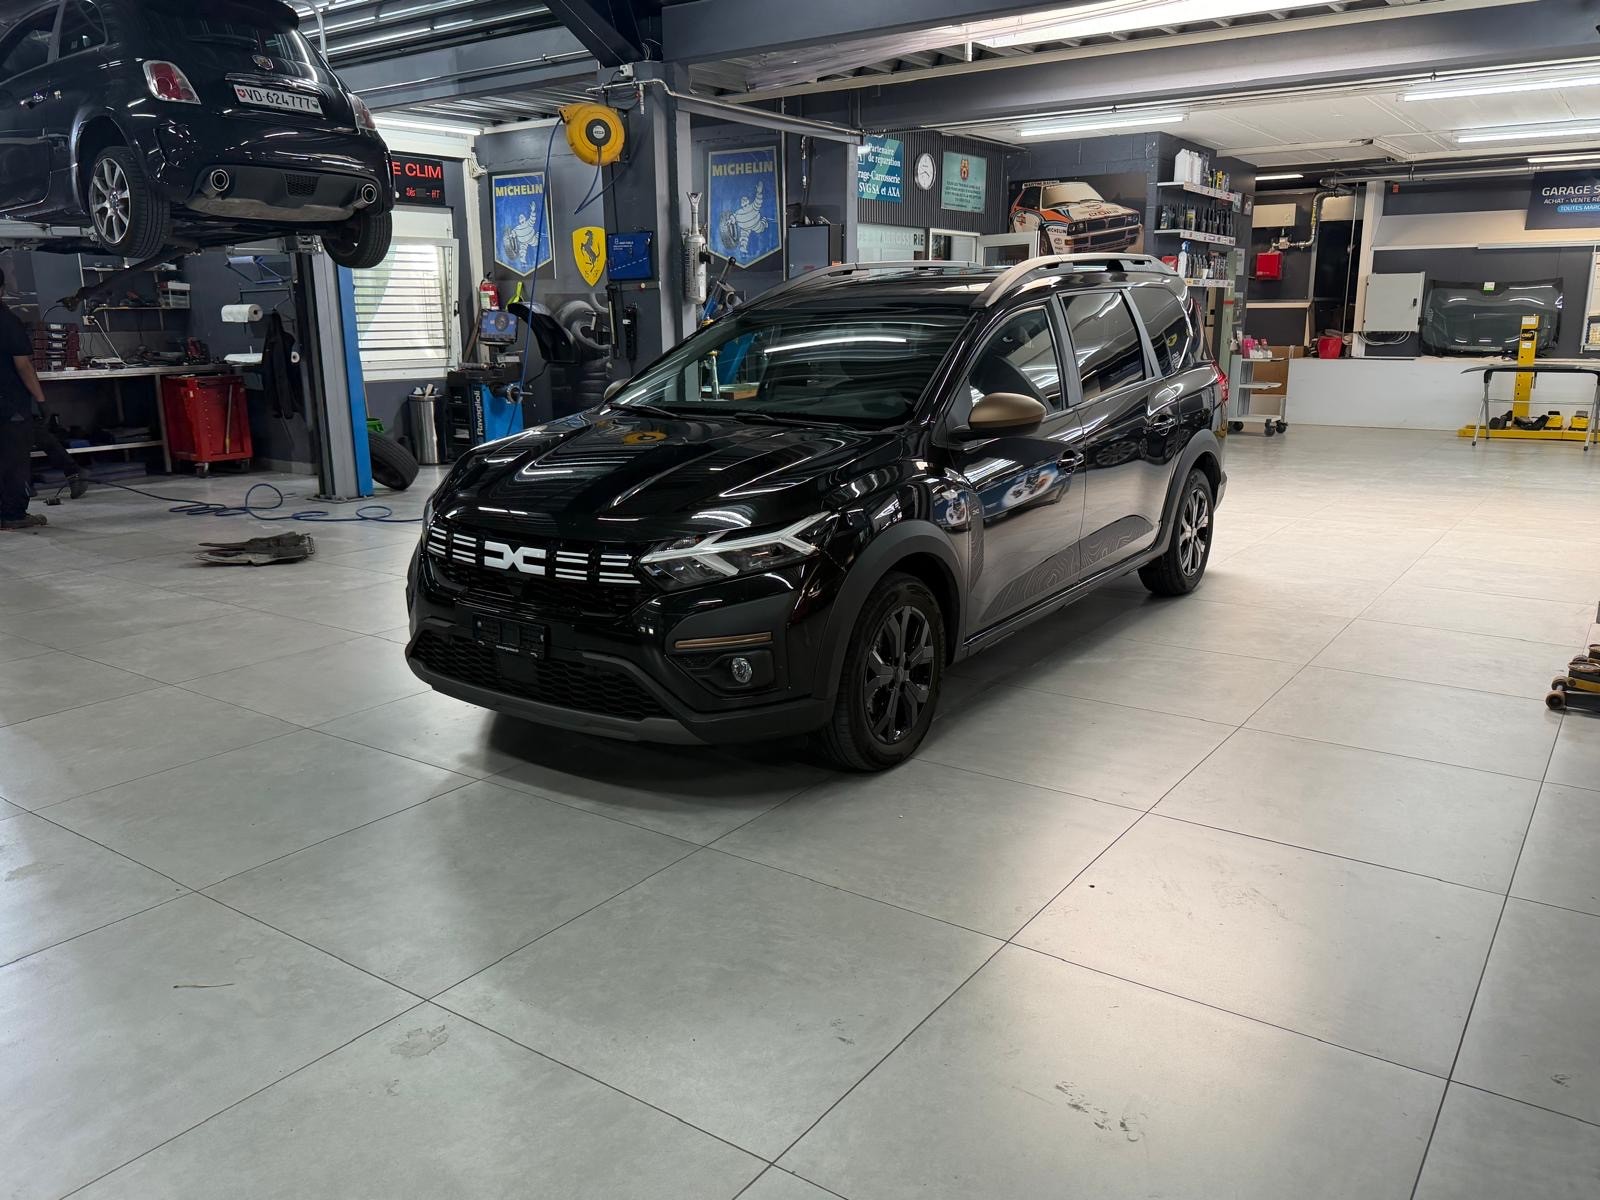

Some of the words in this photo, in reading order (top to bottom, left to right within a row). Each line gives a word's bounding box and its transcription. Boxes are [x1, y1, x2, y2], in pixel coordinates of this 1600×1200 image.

[868, 143, 895, 156] Partenaire
[868, 153, 876, 163] de
[405, 163, 442, 178] CLIM
[711, 160, 774, 177] MICHELIN
[495, 183, 543, 197] MICHELIN
[887, 186, 901, 197] AXA
[1542, 185, 1591, 196] GARAGE
[1570, 196, 1591, 204] VENTE
[474, 390, 483, 436] Ravaglioli
